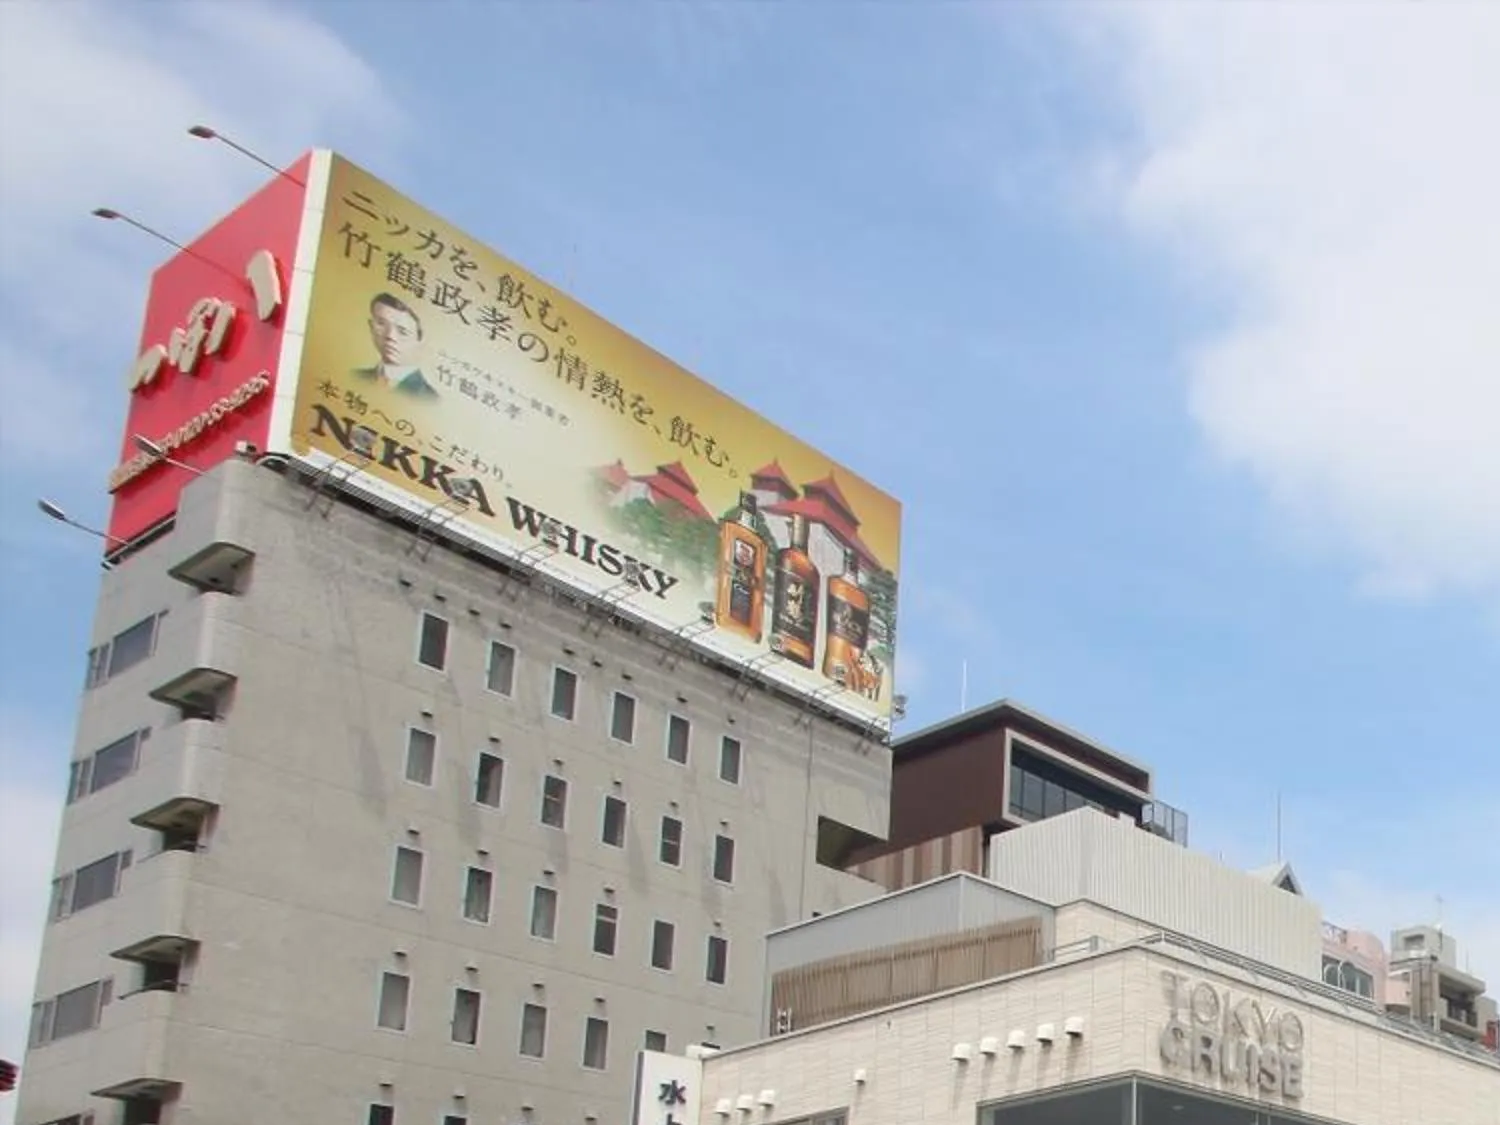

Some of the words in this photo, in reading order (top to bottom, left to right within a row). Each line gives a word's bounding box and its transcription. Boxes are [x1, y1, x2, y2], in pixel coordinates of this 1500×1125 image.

[342, 190, 578, 346] ニッカを、飲む。
[338, 222, 738, 478] 竹鶴政孝の情熱を、飲む。
[506, 496, 679, 599] WHISKY
[1159, 1021, 1304, 1102] CRUISE
[1160, 969, 1304, 1052] TOKYO
